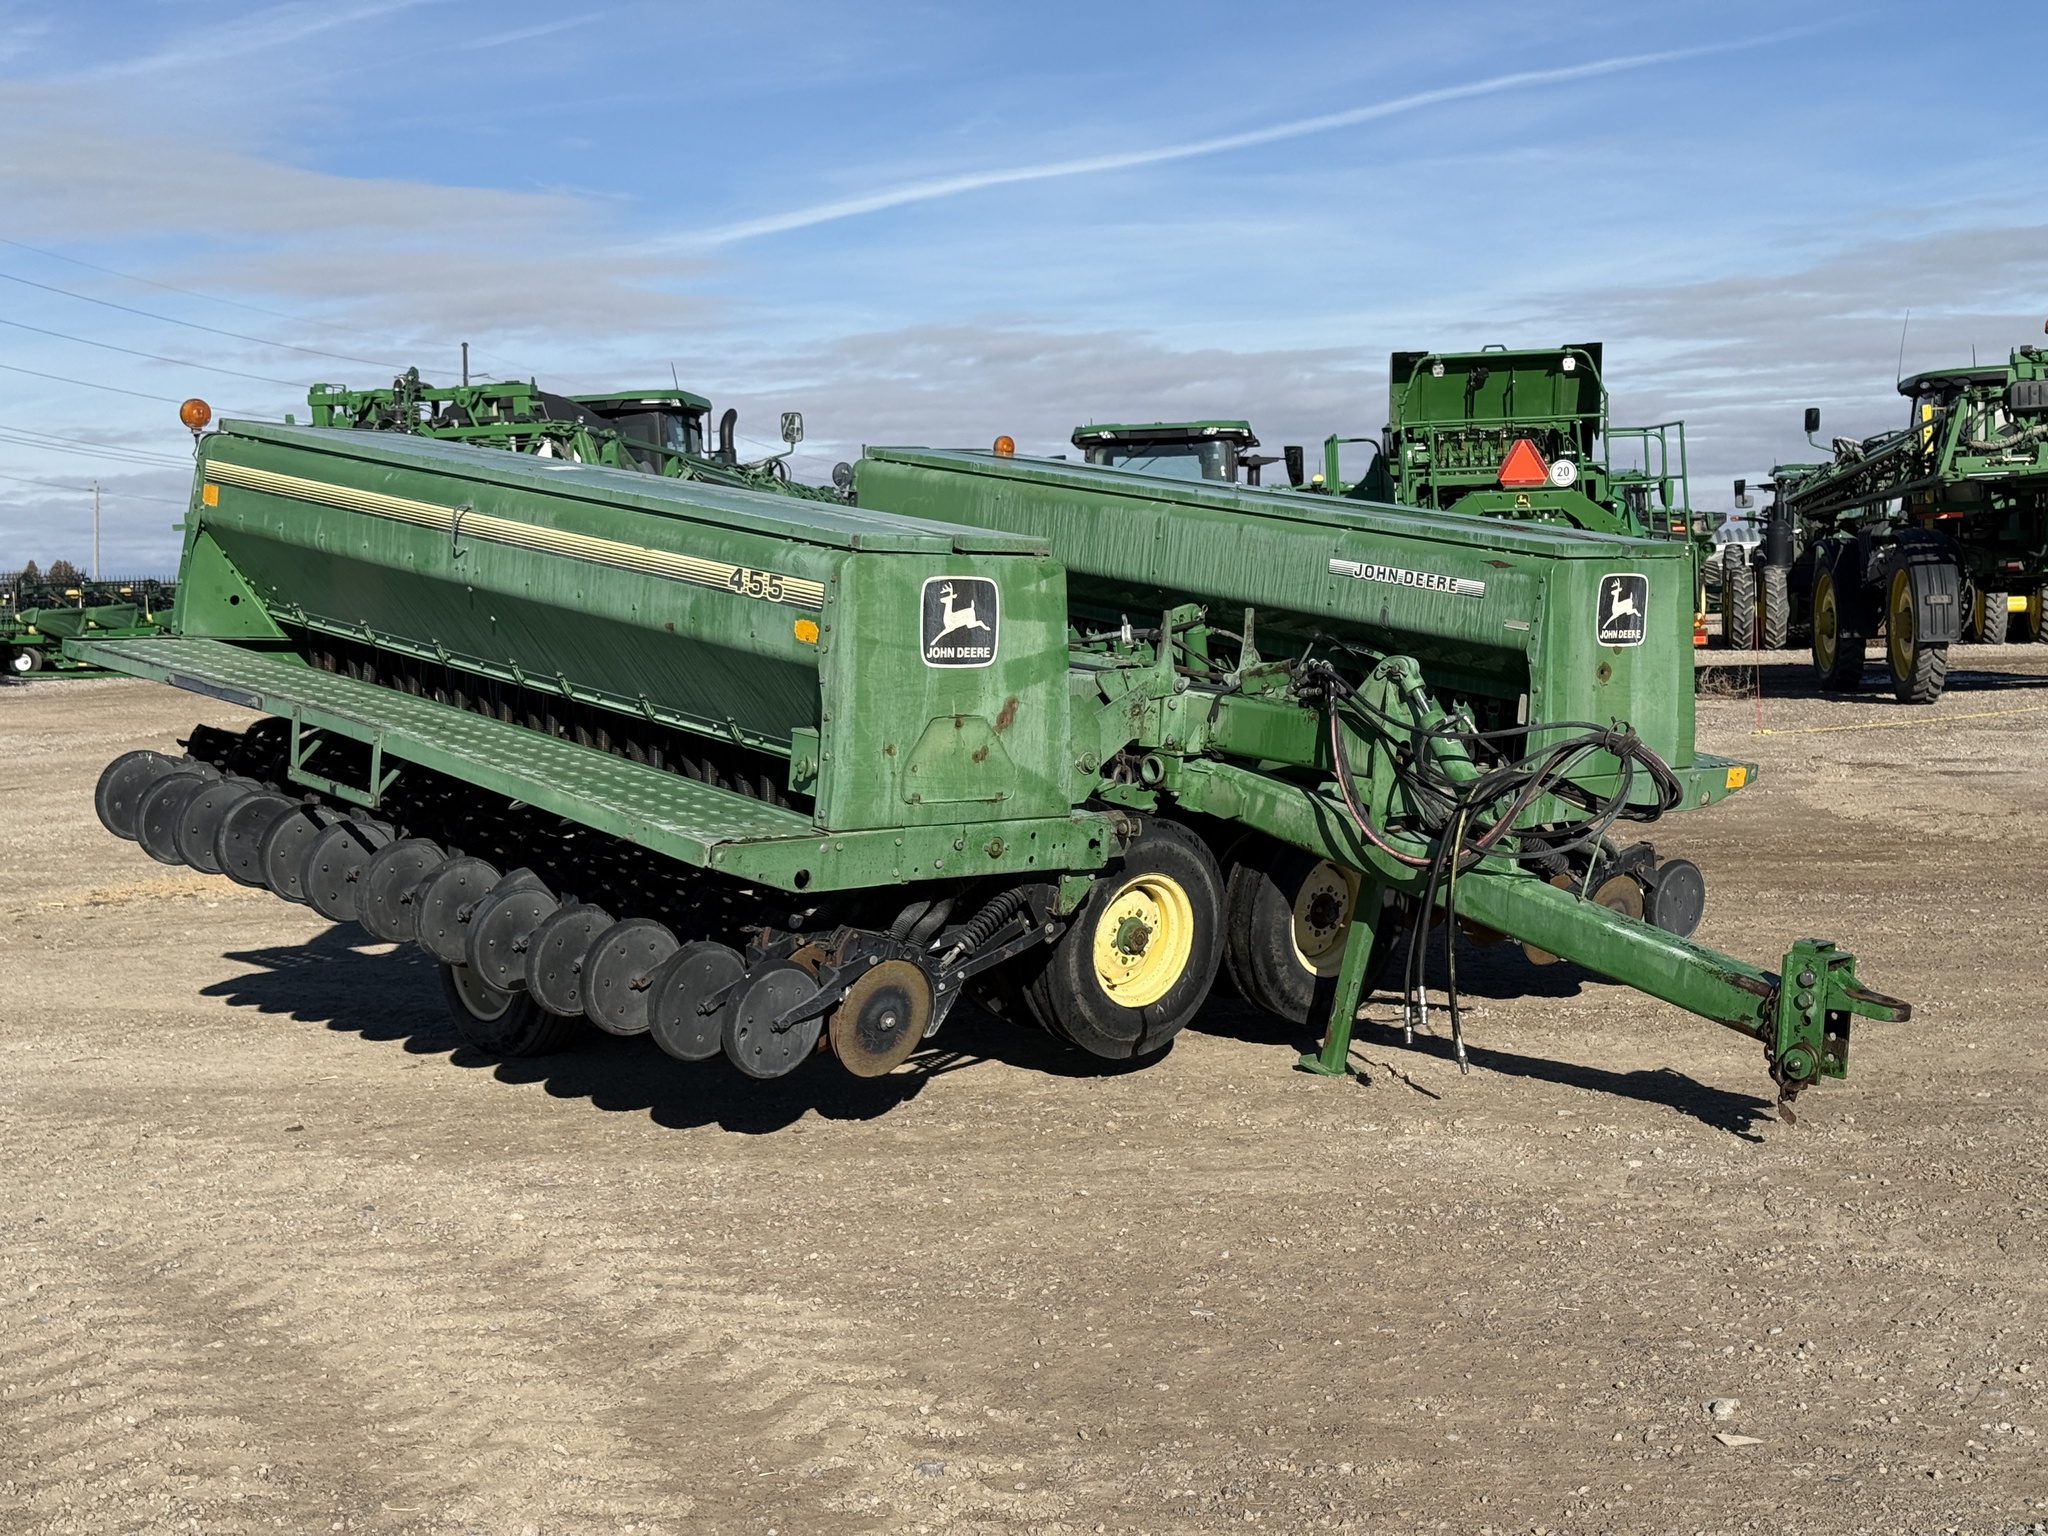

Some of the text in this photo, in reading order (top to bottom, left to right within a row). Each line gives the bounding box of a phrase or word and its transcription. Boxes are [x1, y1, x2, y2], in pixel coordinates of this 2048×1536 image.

[1557, 466, 1570, 477] 20
[729, 567, 784, 601] 455
[1354, 564, 1458, 592] JOHN DEERE
[1600, 629, 1641, 639] JOHN DEERE
[926, 646, 991, 658] JOHN DEERE
